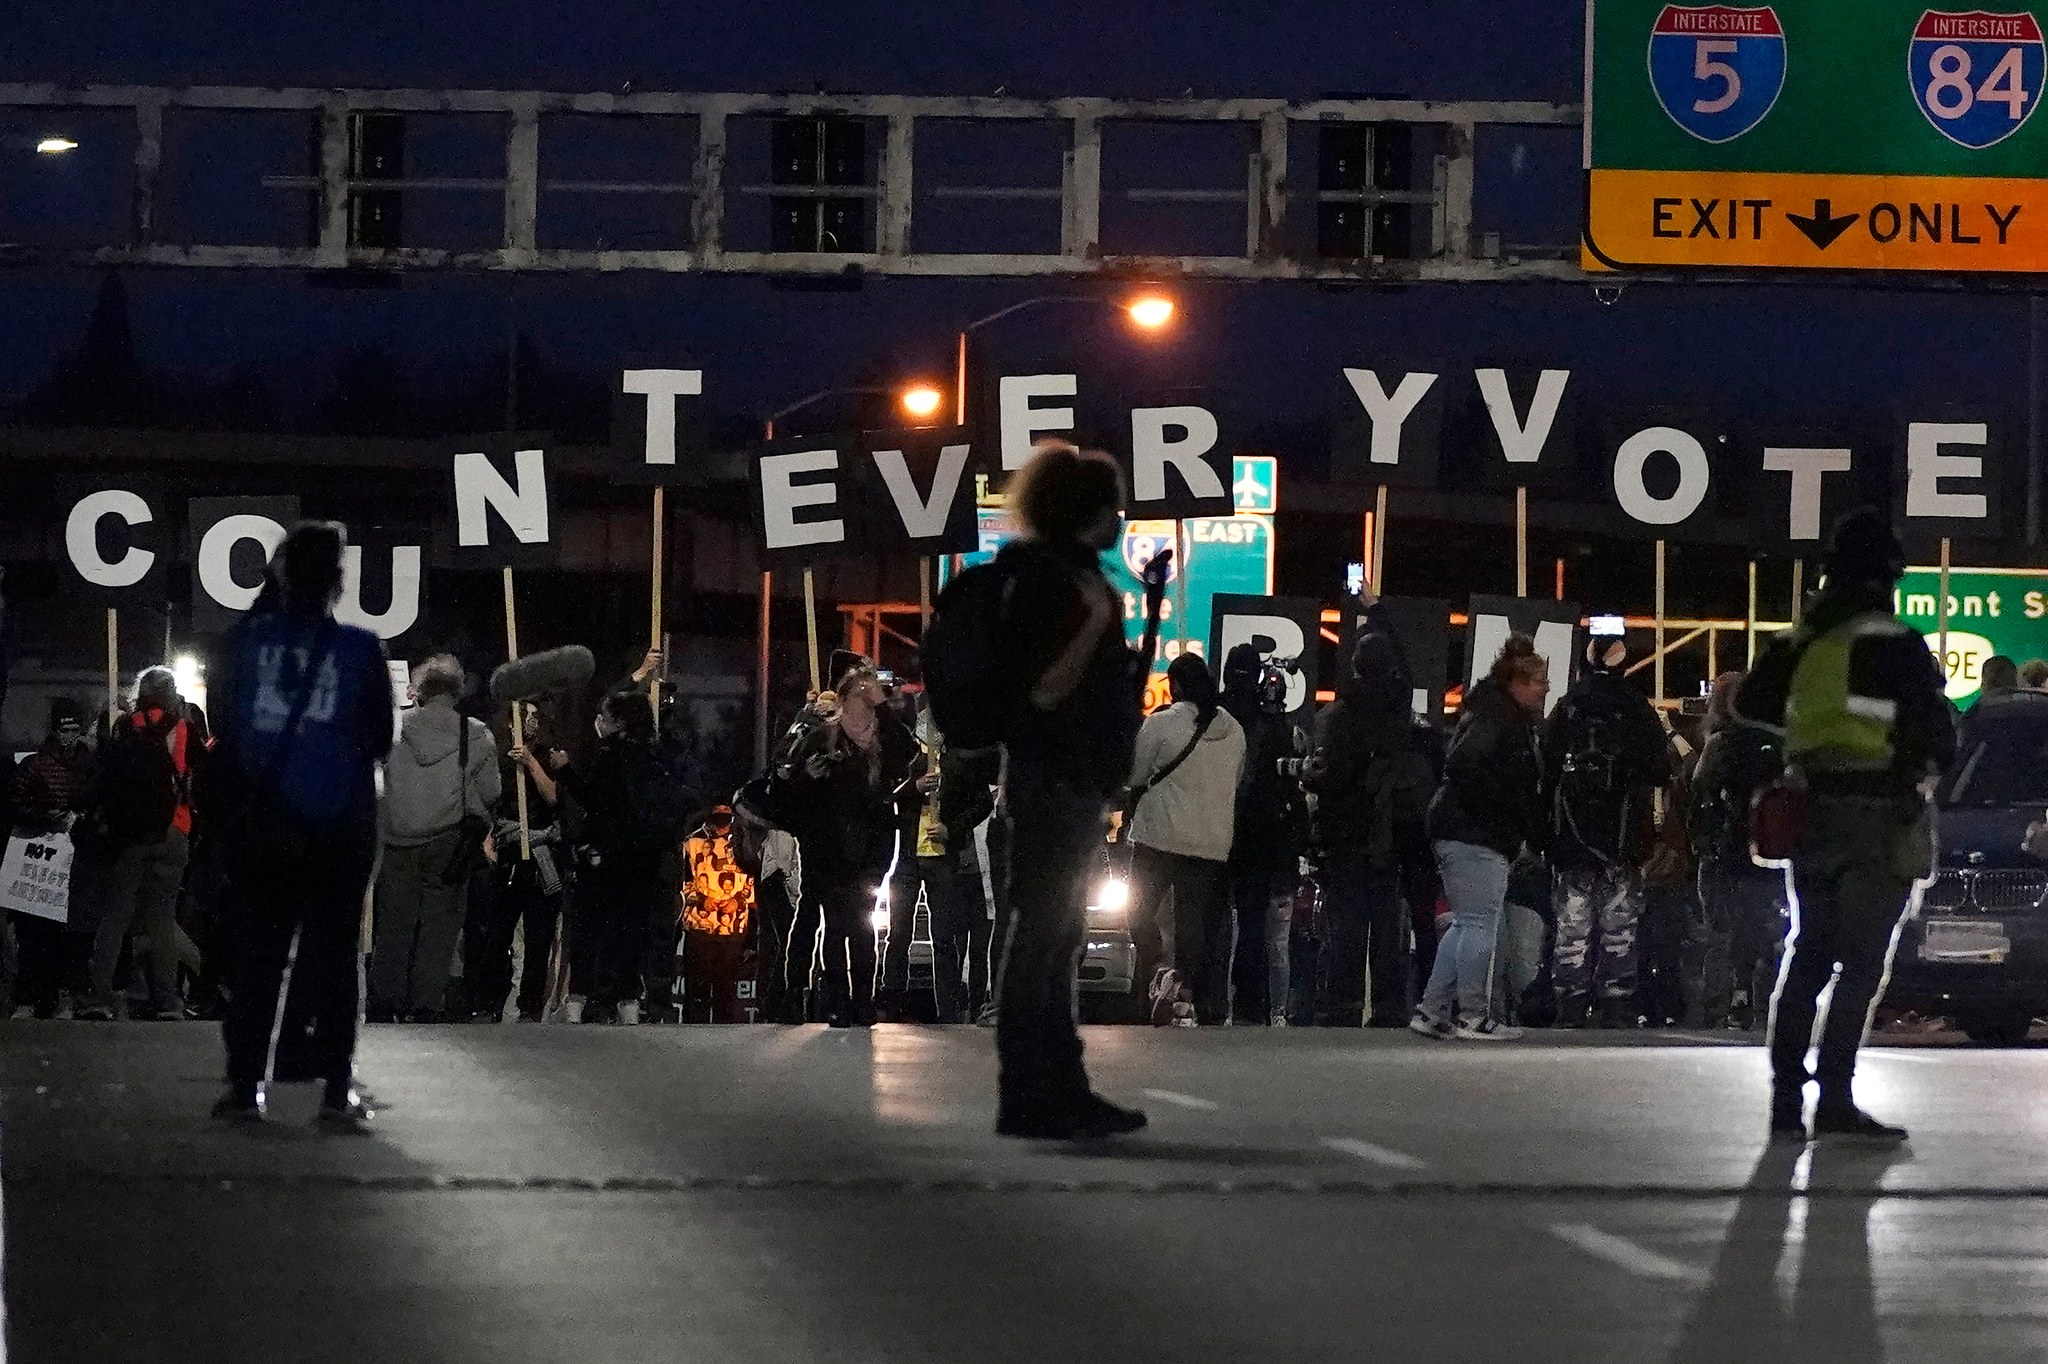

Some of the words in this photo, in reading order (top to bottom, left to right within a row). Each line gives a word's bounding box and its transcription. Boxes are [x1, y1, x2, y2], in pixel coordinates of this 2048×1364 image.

[1673, 12, 1763, 32] INTERSTATE
[1933, 19, 2023, 37] INTERSTATE
[1692, 39, 1742, 114] 5
[1925, 44, 2029, 120] 84
[1652, 197, 1773, 241] EXIT
[1868, 202, 2023, 245] ONLY
[1193, 519, 1258, 544] EAST
[2023, 590, 2048, 619] S
